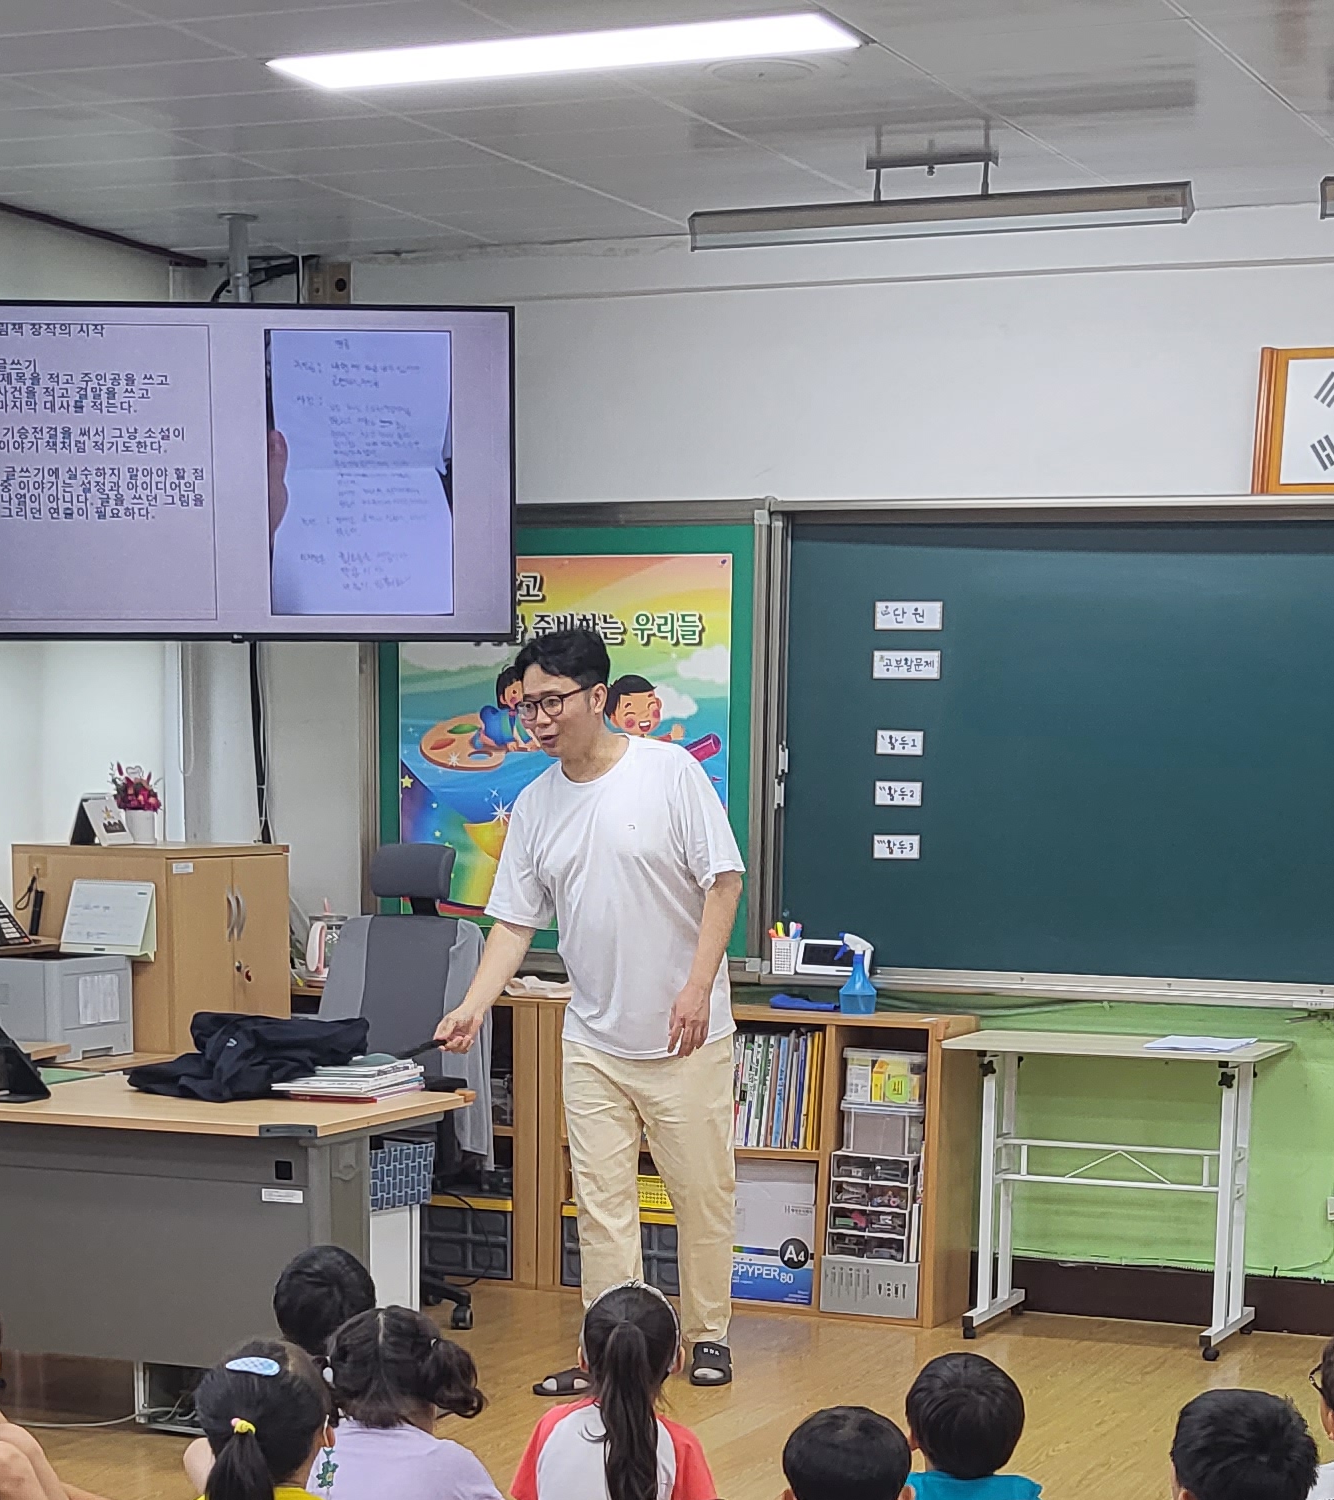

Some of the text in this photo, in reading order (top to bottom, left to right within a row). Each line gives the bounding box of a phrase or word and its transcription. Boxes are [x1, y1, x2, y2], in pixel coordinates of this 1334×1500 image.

[77, 324, 105, 337] 시작
[0, 372, 170, 387] 제목을 적고 주인공을 쓰고
[43, 387, 70, 400] 적고
[76, 386, 118, 400] 결말을
[123, 388, 151, 400] 쓰고
[44, 400, 85, 414] 대사를
[91, 400, 137, 414] 적는다.
[3, 426, 72, 440] 기승전결을
[78, 427, 105, 440] 써서
[111, 427, 138, 440] 그냥
[44, 440, 86, 454] 책처럼
[4, 467, 204, 481] 글쓰기에 실수하지 말아야 할 점
[0, 480, 196, 494] 중 이야기는 설정과 아이디어의
[1, 493, 42, 507] 나열이
[100, 493, 125, 507] 글을
[131, 493, 158, 507] 쓰던
[163, 493, 204, 507] 그림을
[1, 507, 42, 520] 그리던
[517, 573, 543, 600] 고
[632, 612, 702, 644] 우리들
[784, 1245, 805, 1262] A4
[780, 1273, 793, 1283] 80
